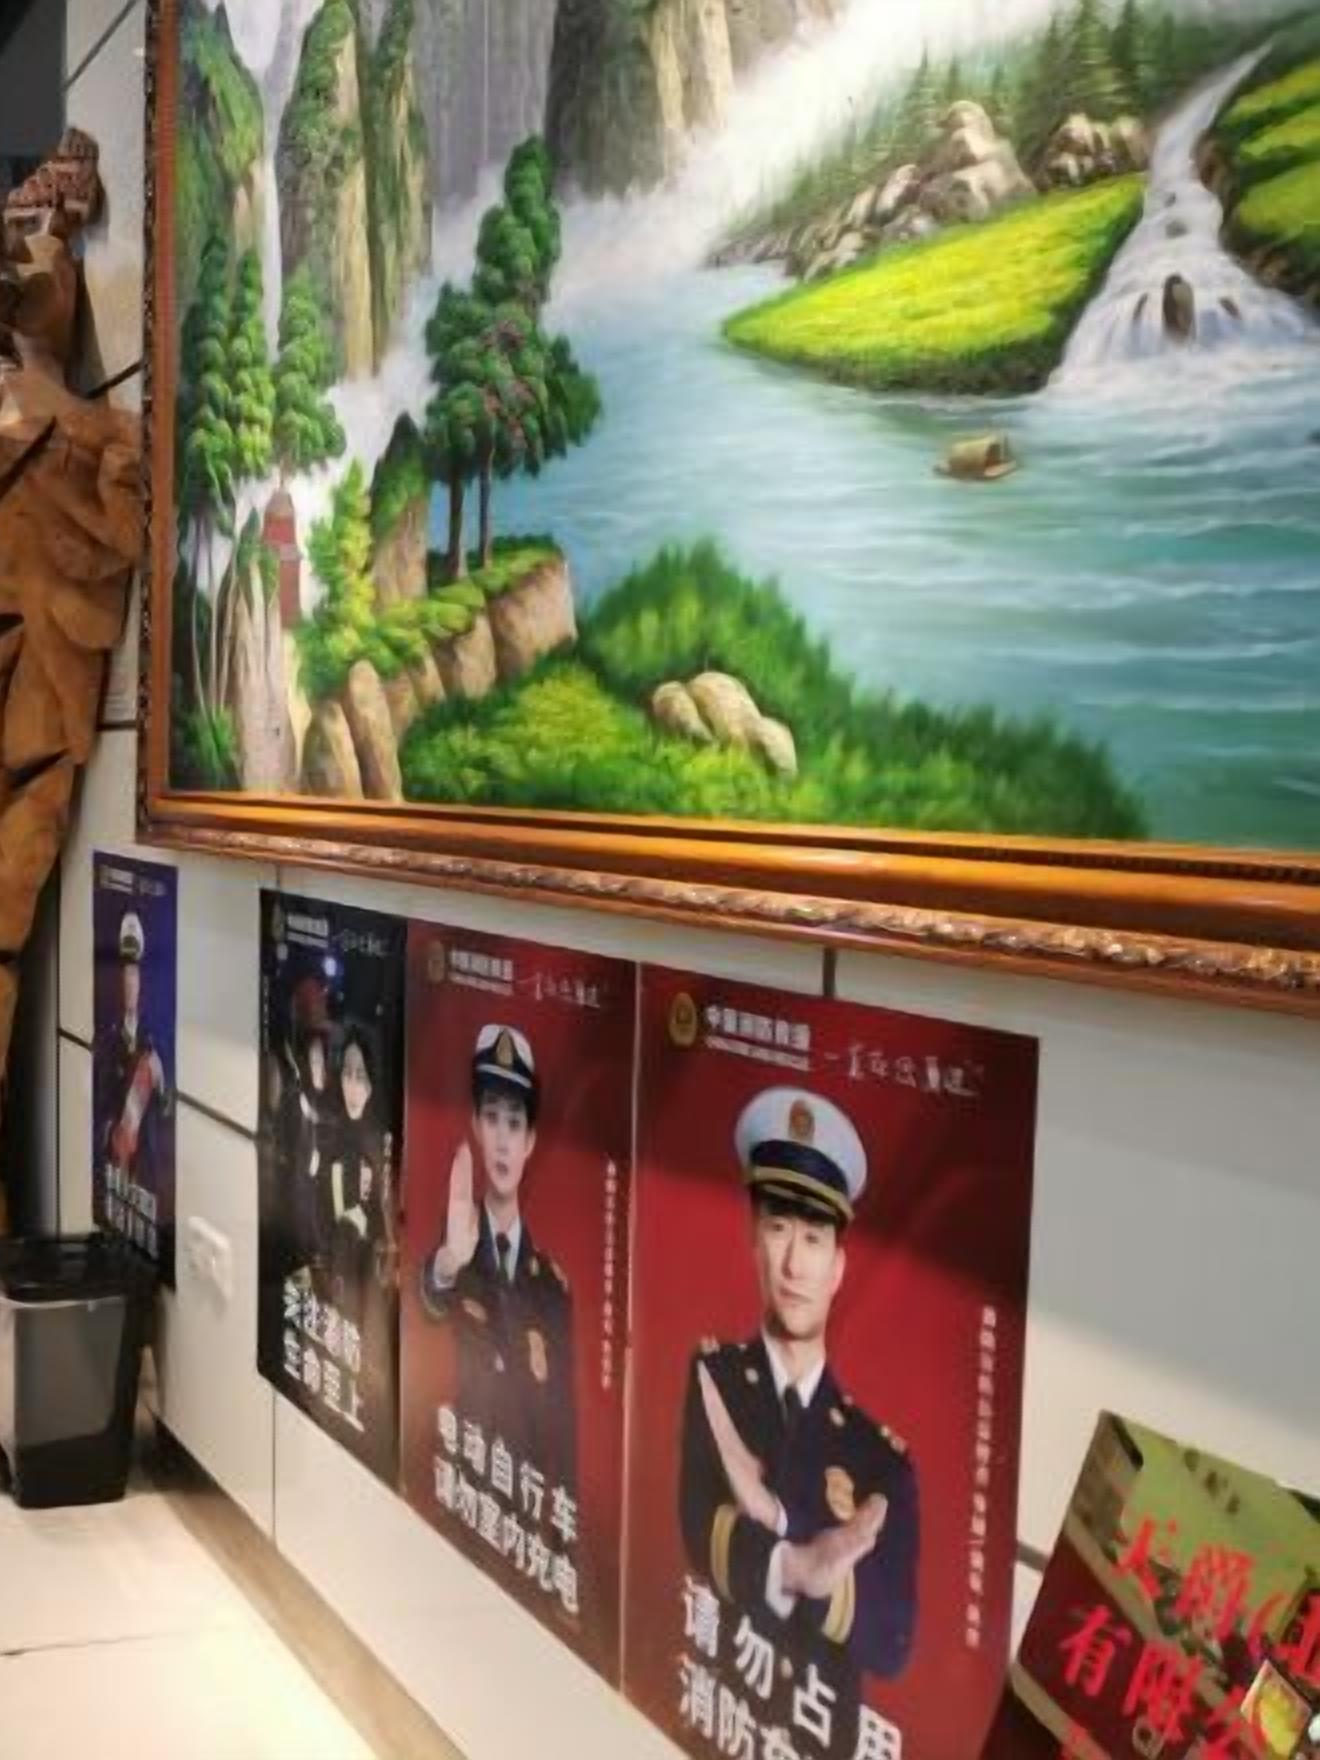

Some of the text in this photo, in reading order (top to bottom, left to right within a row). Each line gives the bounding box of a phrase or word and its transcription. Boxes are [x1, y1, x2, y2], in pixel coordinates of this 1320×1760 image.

[434, 1454, 579, 1615] 请勿室内充电
[437, 1405, 578, 1542] 电动自行车
[683, 1574, 902, 1760] 请勿占用
